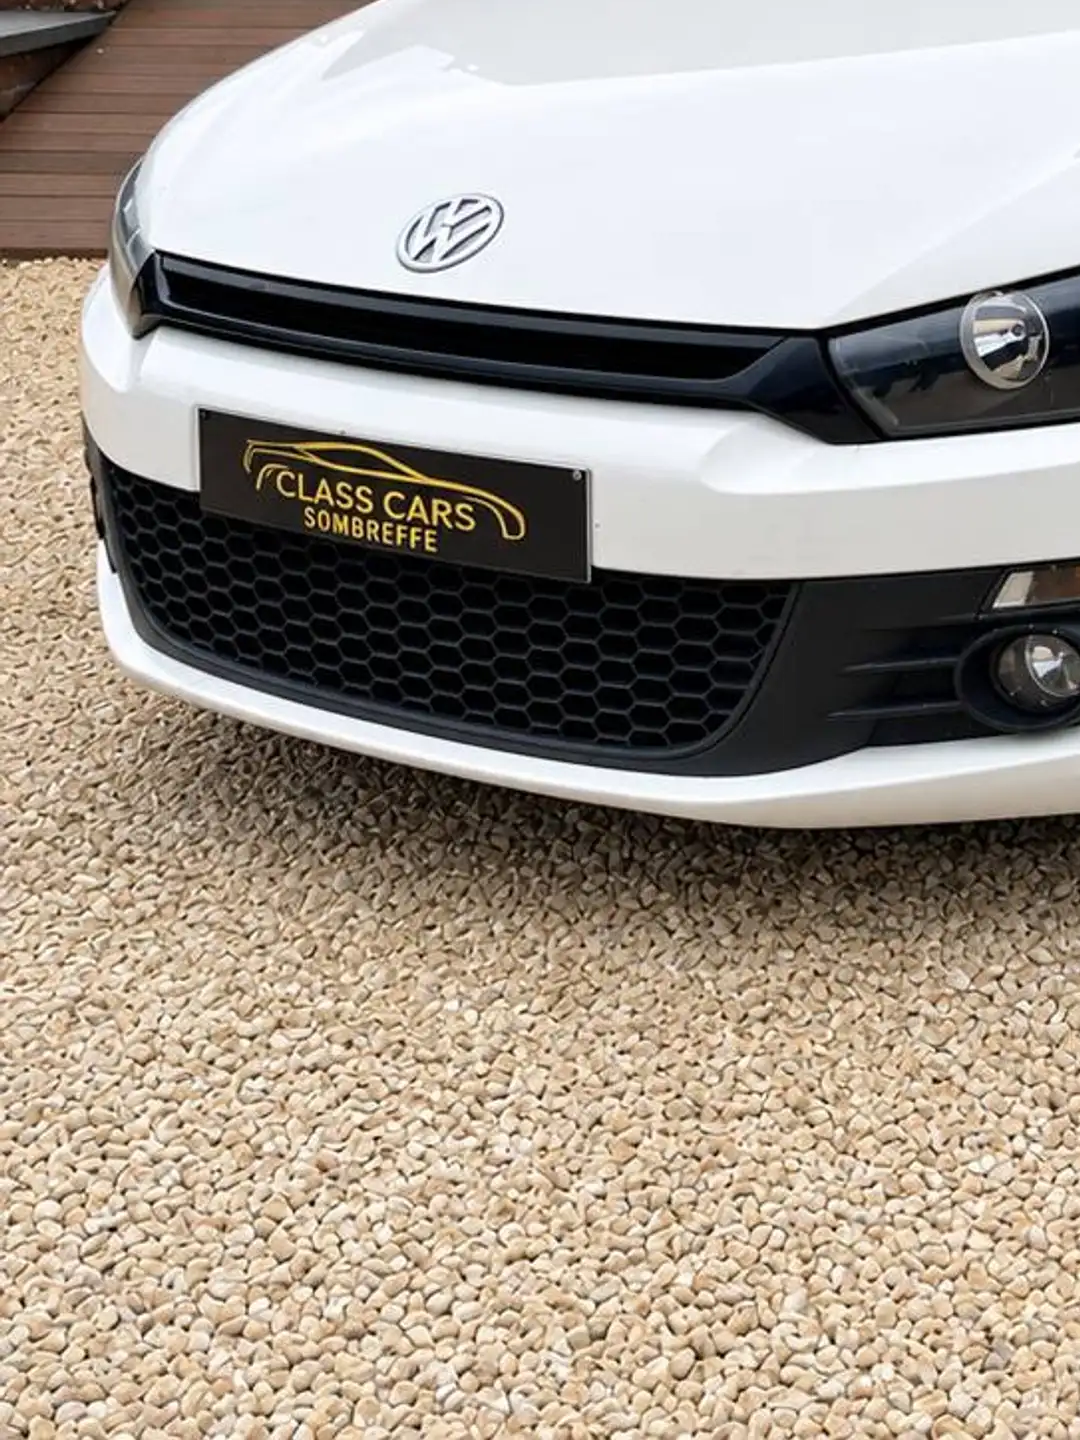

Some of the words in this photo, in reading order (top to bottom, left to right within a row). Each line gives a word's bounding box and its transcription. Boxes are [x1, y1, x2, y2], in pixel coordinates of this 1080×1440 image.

[276, 471, 374, 515] CLASS
[383, 491, 477, 532] CARS
[303, 506, 438, 553] SOMBREFFE
